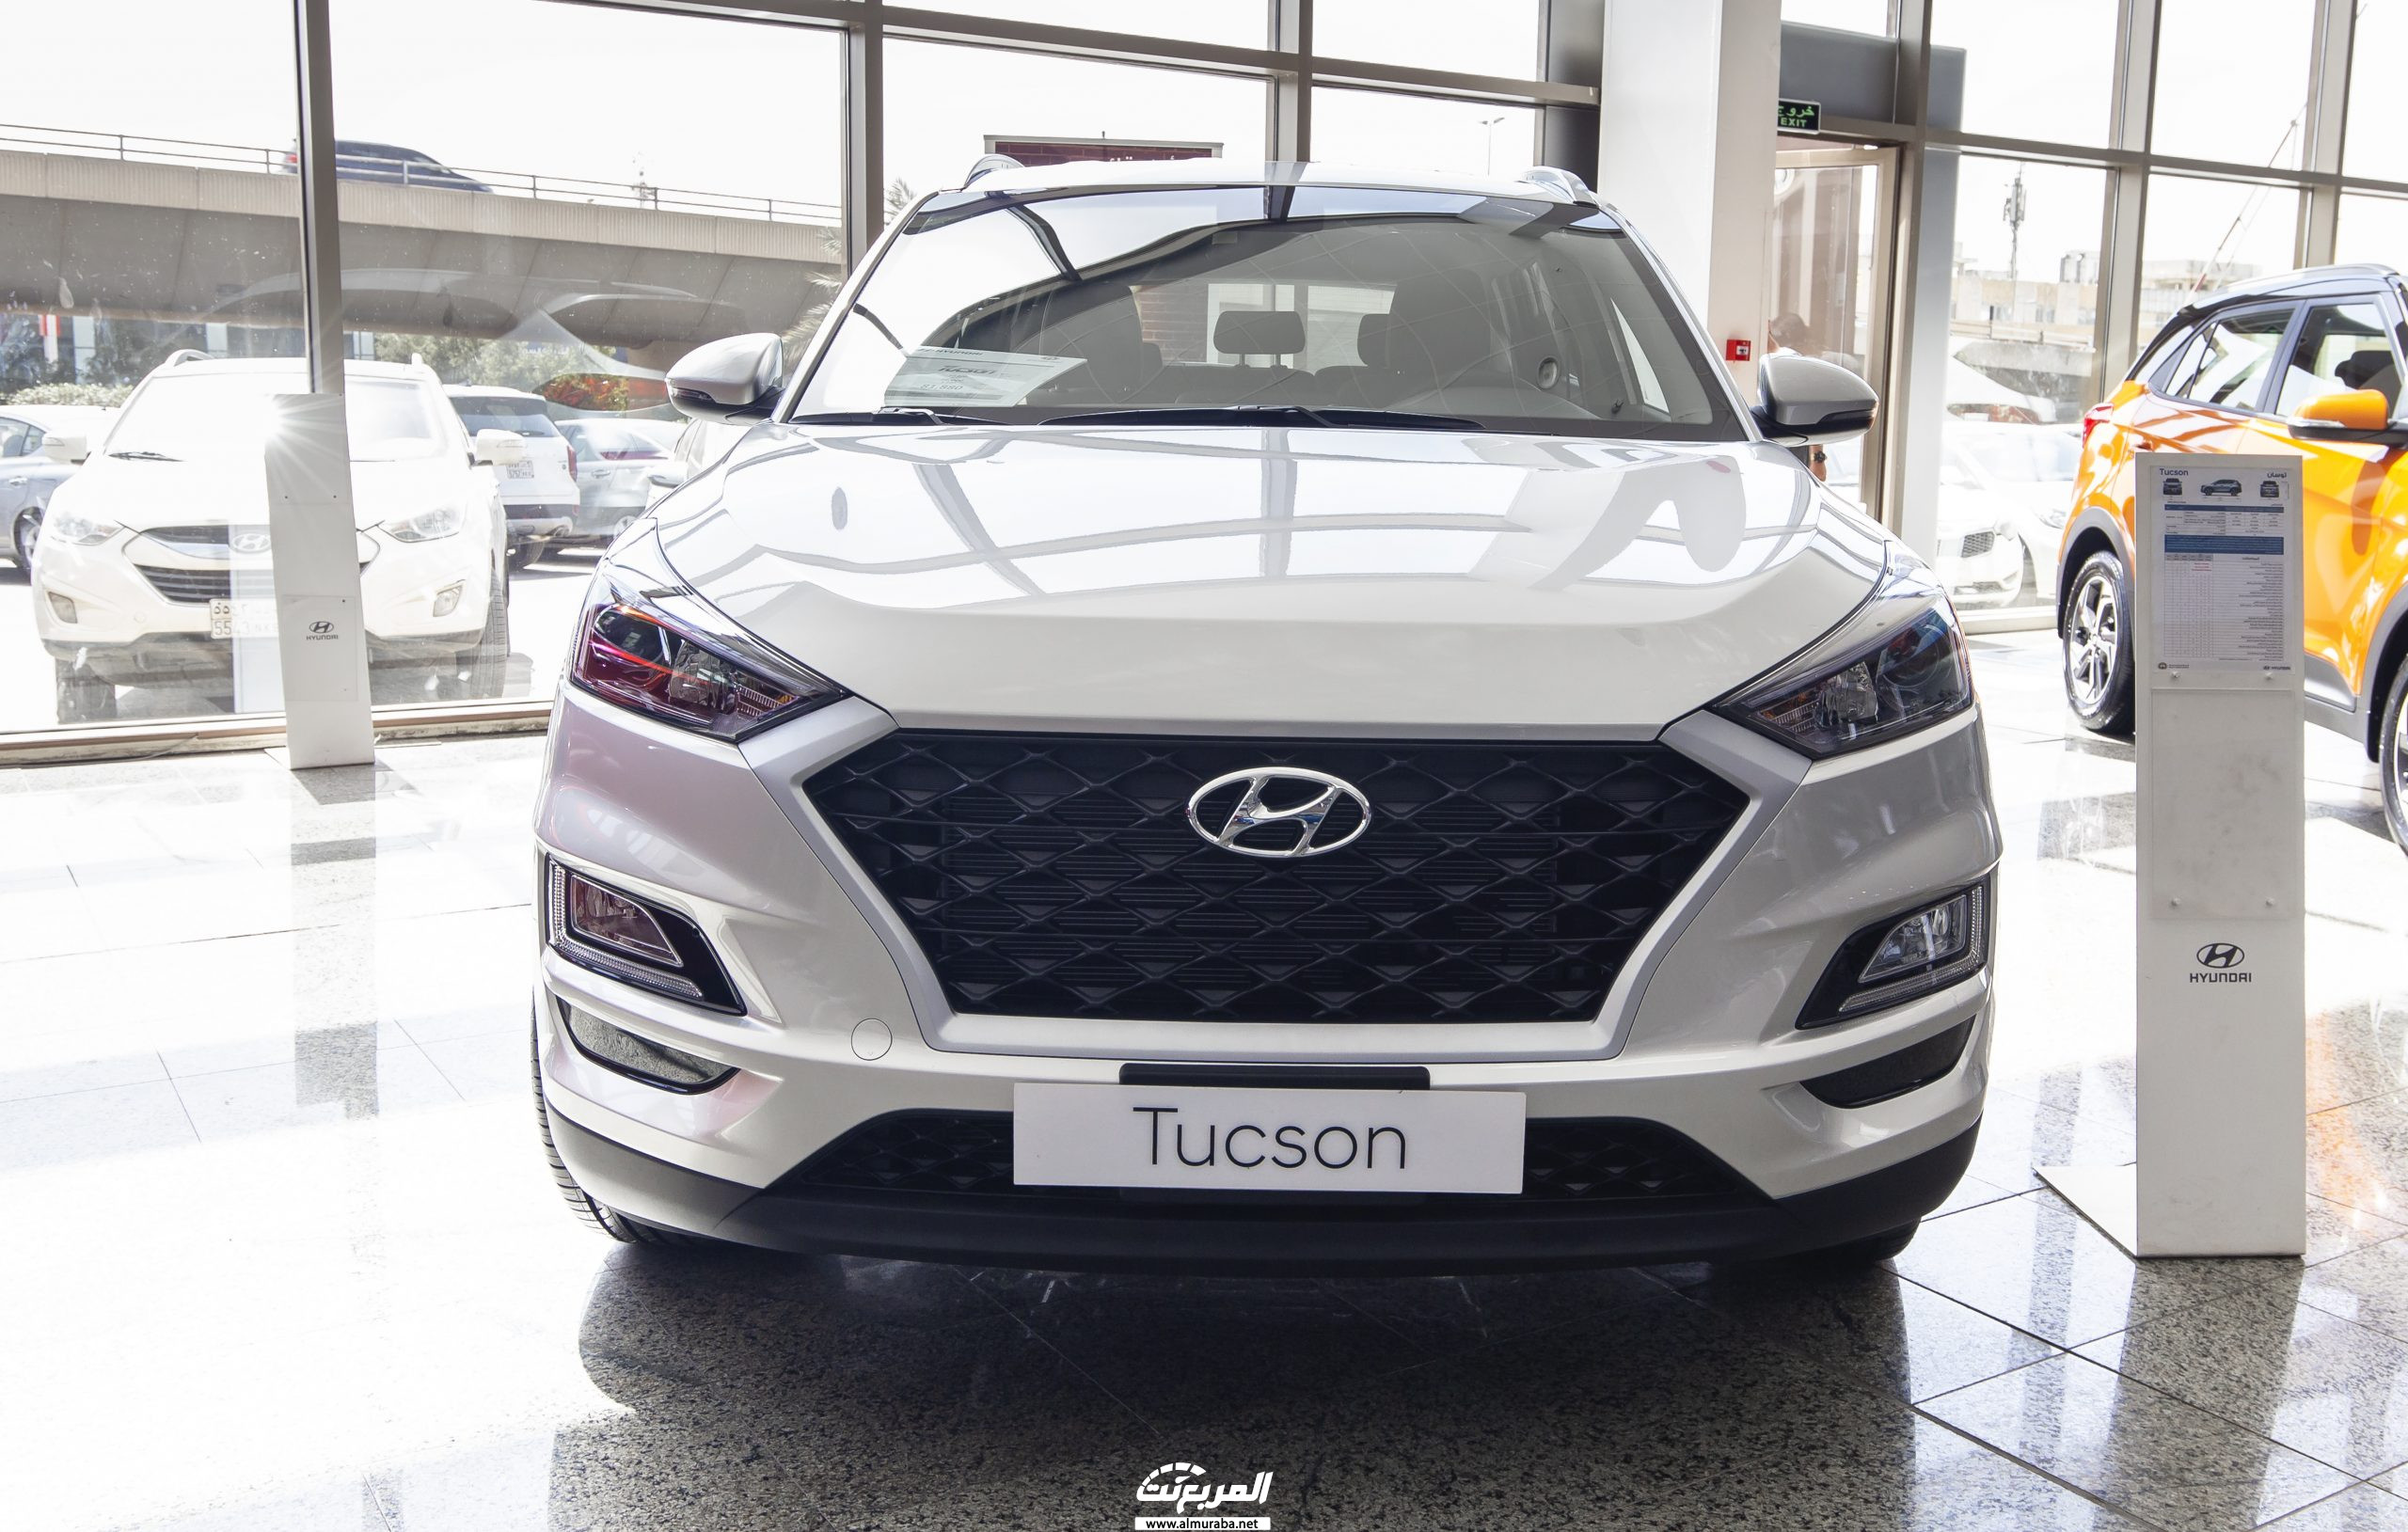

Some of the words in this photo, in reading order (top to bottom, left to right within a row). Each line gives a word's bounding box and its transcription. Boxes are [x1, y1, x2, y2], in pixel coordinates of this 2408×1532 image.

[1781, 118, 1807, 127] EXIT
[2190, 972, 2252, 983] HYUNDAI
[1133, 1106, 1407, 1170] Tucson
